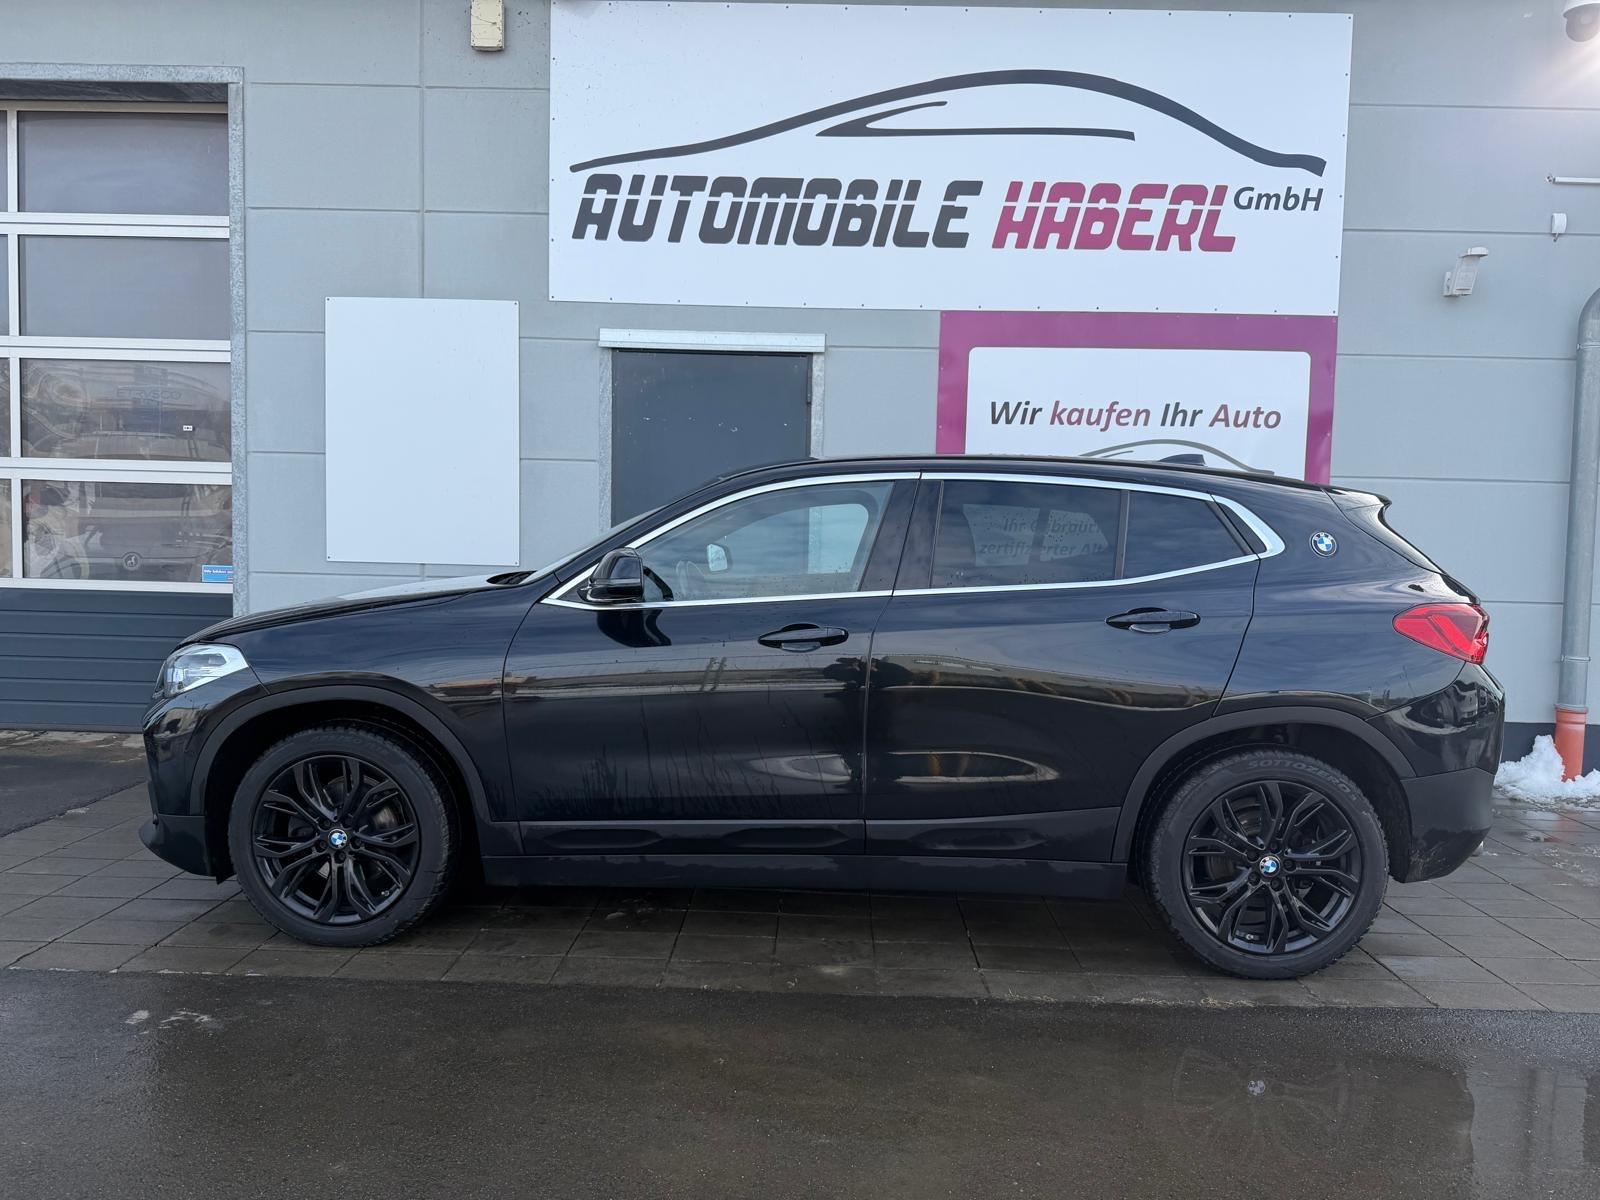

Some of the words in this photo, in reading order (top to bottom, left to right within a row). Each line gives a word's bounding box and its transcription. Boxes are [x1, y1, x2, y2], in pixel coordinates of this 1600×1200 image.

[573, 173, 983, 249] AUTOMOBILE
[992, 181, 1236, 253] HABERL
[1233, 186, 1323, 213] GmbH
[990, 401, 1043, 425] Wir
[1049, 401, 1150, 432] kaufen
[1160, 402, 1203, 427] Ihr
[1209, 404, 1282, 429] Auto
